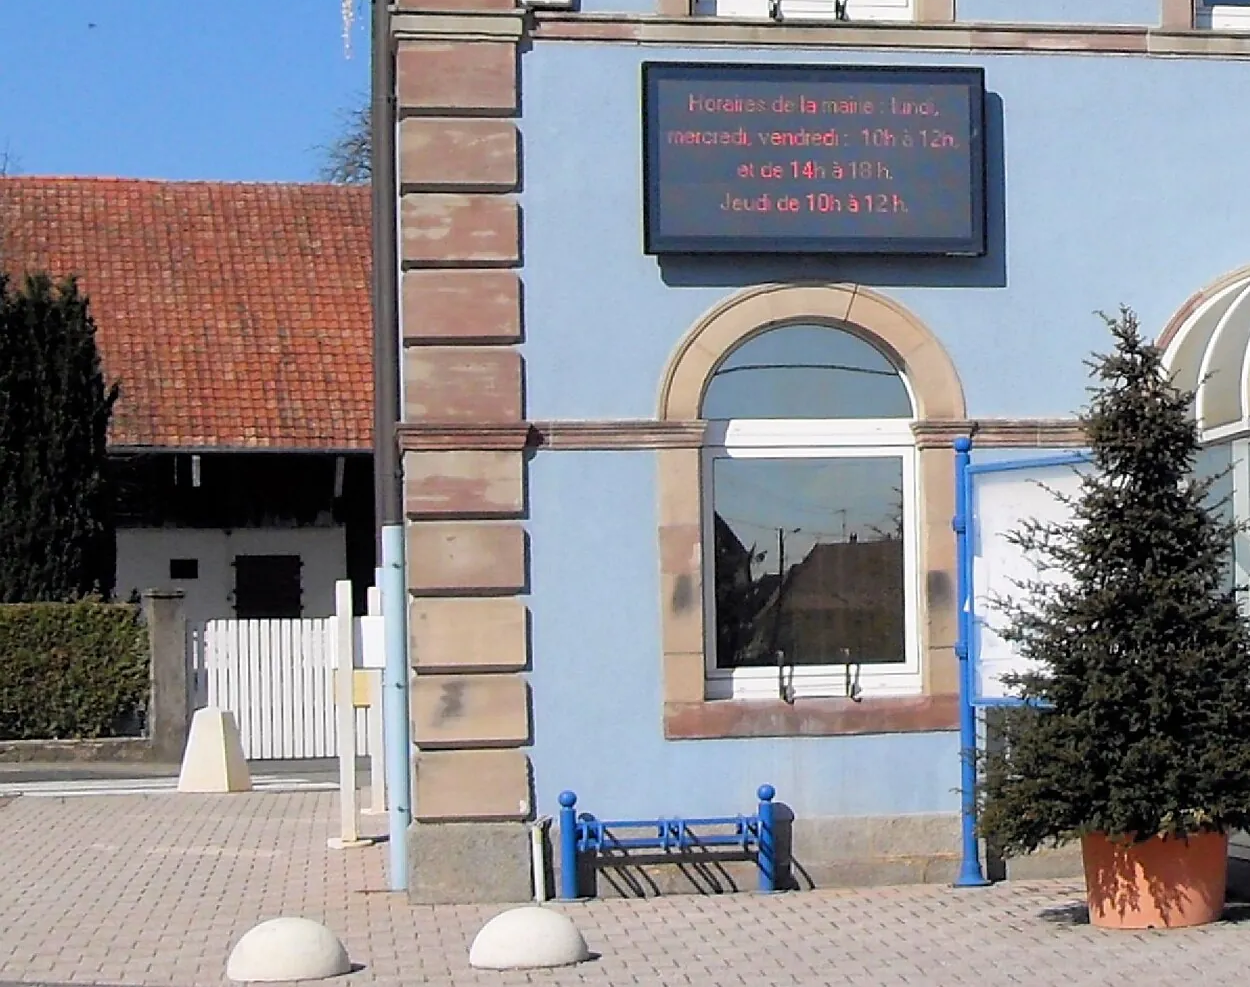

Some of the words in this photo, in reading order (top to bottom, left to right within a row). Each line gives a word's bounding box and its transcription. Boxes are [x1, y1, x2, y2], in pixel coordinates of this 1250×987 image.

[688, 92, 767, 113] Horaires
[772, 94, 795, 113] de
[800, 94, 818, 114] la
[861, 128, 895, 148] 10h
[901, 128, 914, 148] à
[736, 162, 755, 179] et
[760, 160, 783, 179] de
[789, 160, 826, 180] 14h
[831, 161, 844, 180] à
[720, 192, 772, 212] Jeudi
[776, 194, 800, 213] de
[806, 193, 841, 213] 10h
[848, 193, 860, 213] à
